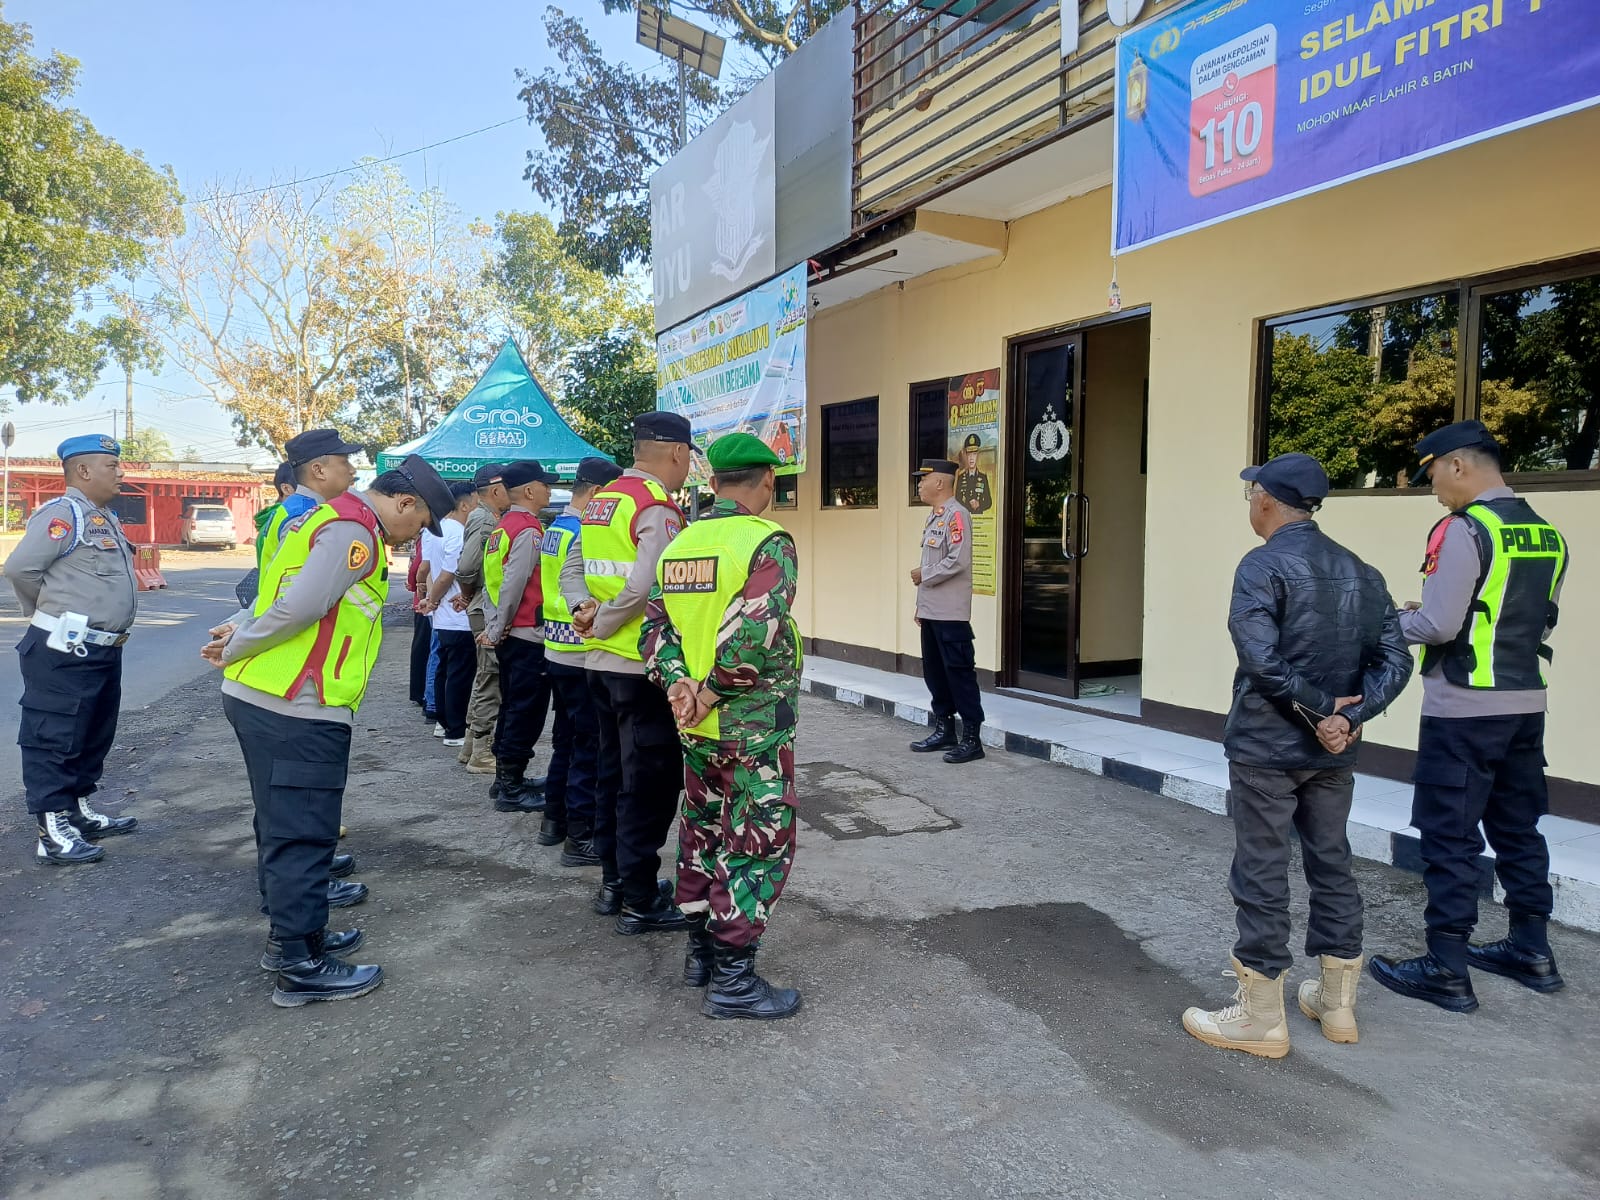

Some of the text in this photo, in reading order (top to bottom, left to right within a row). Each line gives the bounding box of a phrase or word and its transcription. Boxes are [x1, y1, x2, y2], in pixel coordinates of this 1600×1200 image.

[1299, 0, 1435, 60] SELAM
[1195, 34, 1270, 75] LAYANAN KEPOLISIAN
[1198, 48, 1266, 85] DALAM GENGGAMAN
[1299, 0, 1503, 104] IDUL FITRI
[1296, 58, 1474, 133] MOHON MAAF LAHIR & BATIN
[1199, 101, 1263, 170] 110
[727, 322, 769, 362] SUKALUYU
[725, 360, 761, 393] BERSAMA
[463, 405, 542, 427] Grab
[950, 405, 959, 428] 8
[479, 437, 524, 445] HEMAT
[664, 559, 715, 584] KODIM
[695, 582, 713, 590] CJR
